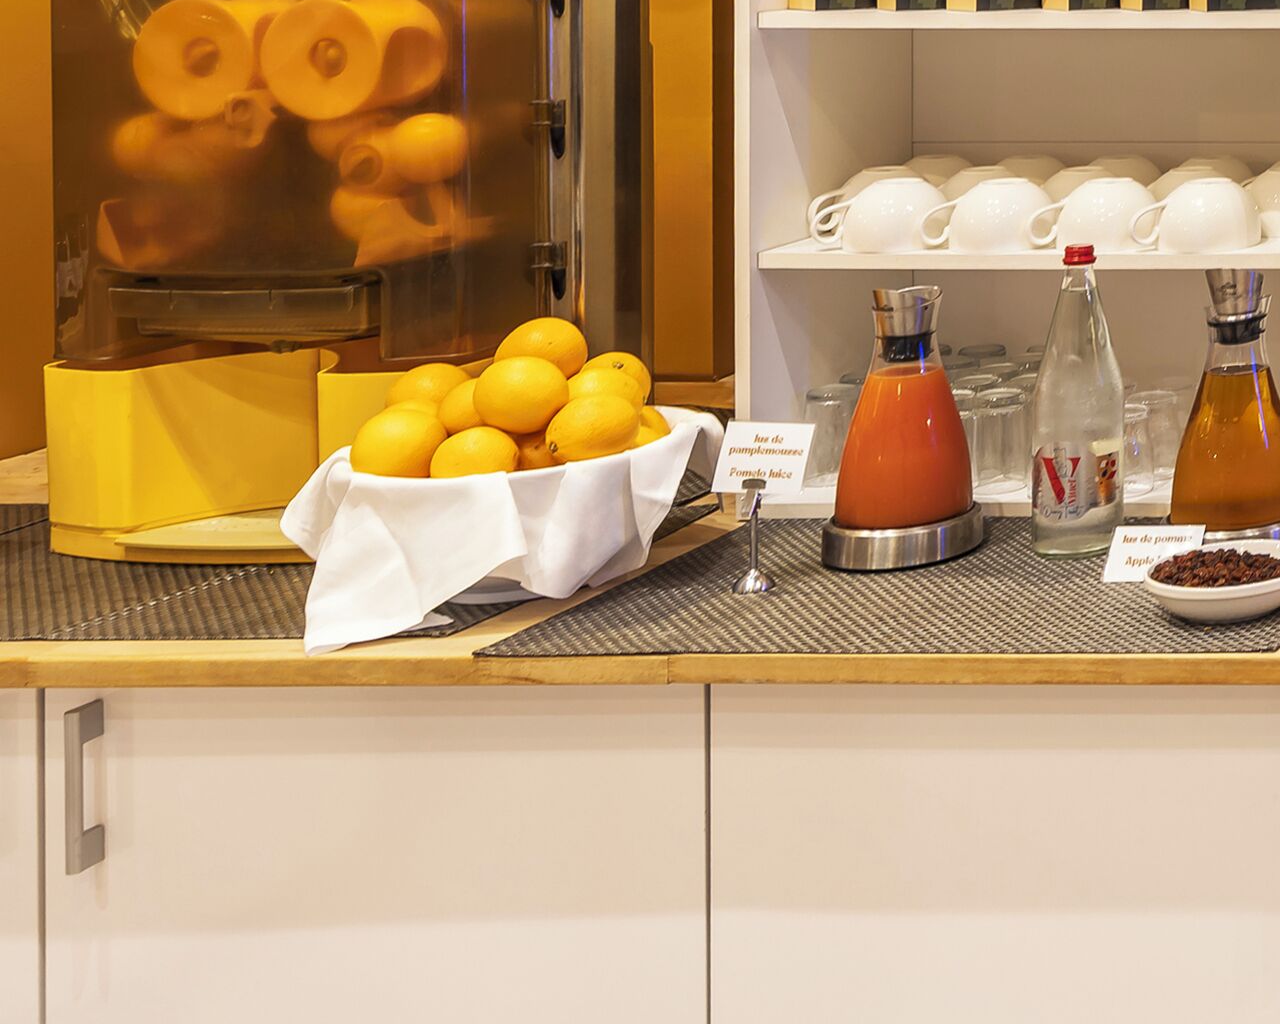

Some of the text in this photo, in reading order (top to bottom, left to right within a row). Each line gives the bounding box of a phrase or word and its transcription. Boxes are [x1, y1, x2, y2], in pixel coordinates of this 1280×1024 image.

[771, 435, 784, 444] de
[728, 446, 804, 456] pamplemousse
[729, 467, 766, 478] Pomelo
[1140, 534, 1152, 543] de
[1125, 556, 1154, 567] Apple
